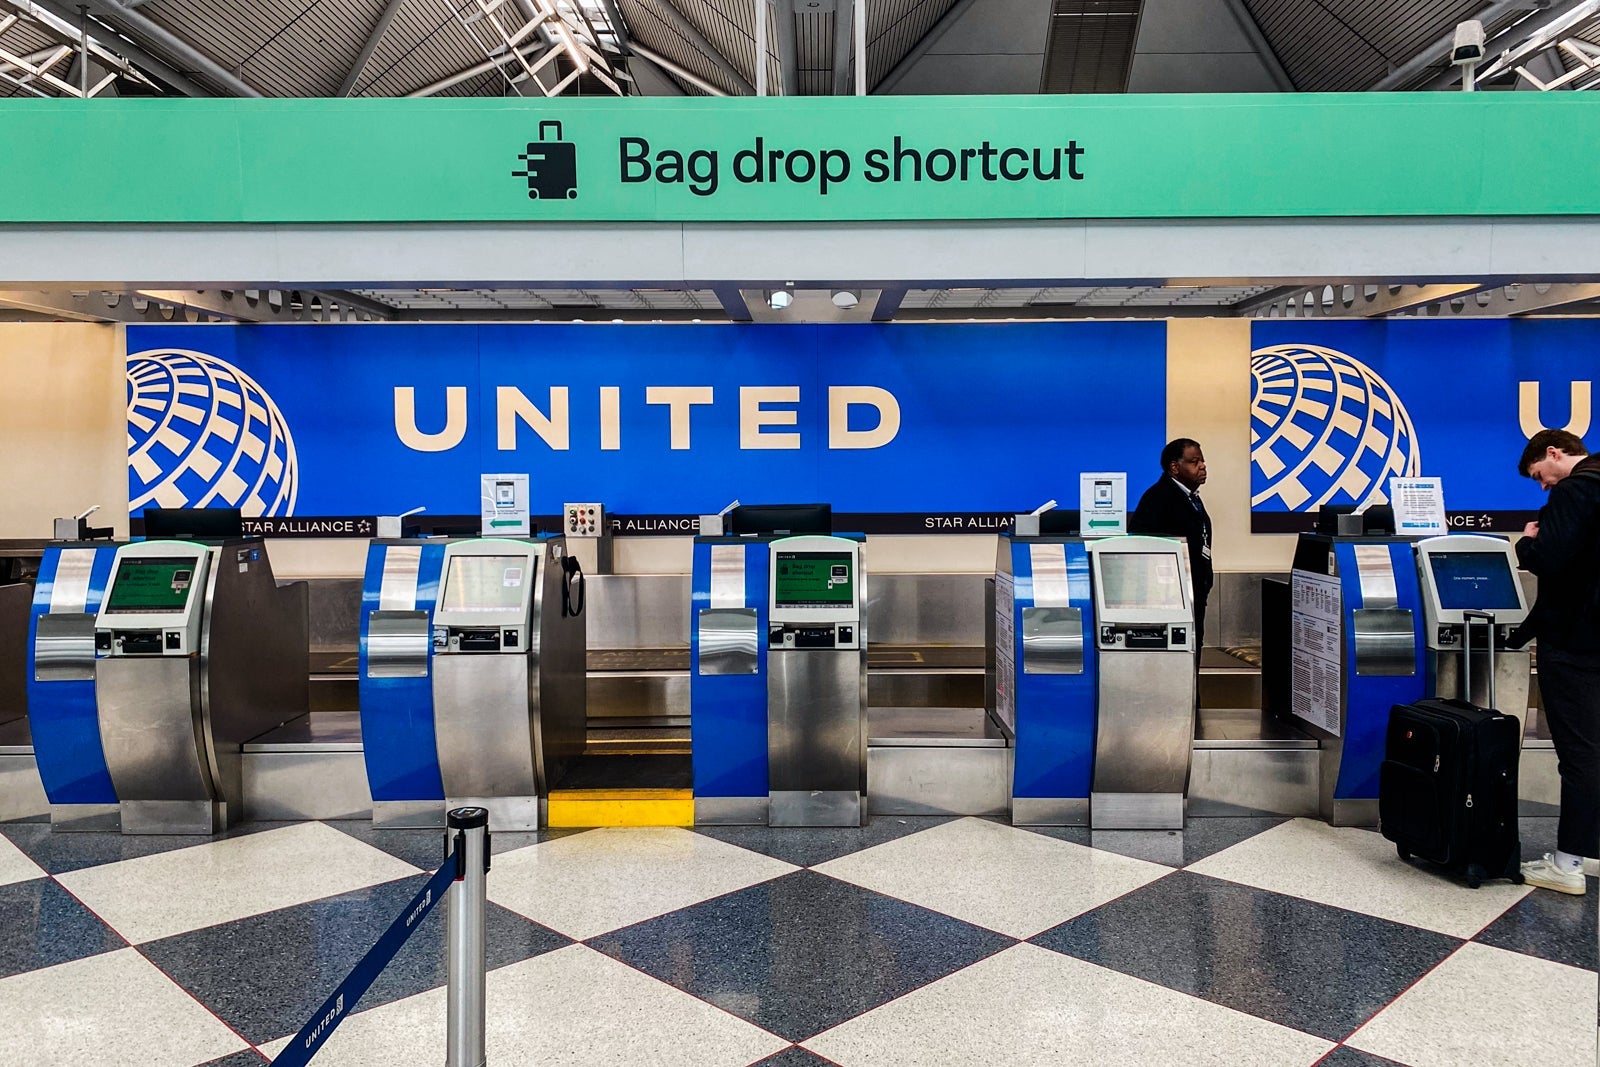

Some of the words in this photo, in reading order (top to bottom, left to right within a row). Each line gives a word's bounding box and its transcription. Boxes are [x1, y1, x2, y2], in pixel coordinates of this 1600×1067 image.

[620, 137, 718, 196] Bag
[733, 137, 850, 195] drop
[864, 136, 1084, 183] shortcut
[393, 385, 902, 451] UNITED
[241, 521, 274, 533] TAR
[278, 521, 354, 533] ALLIANCE
[626, 519, 700, 530] ALLIANCE
[925, 517, 963, 528] STAR
[406, 900, 425, 927] UNITED
[305, 1009, 335, 1048] UNITED
